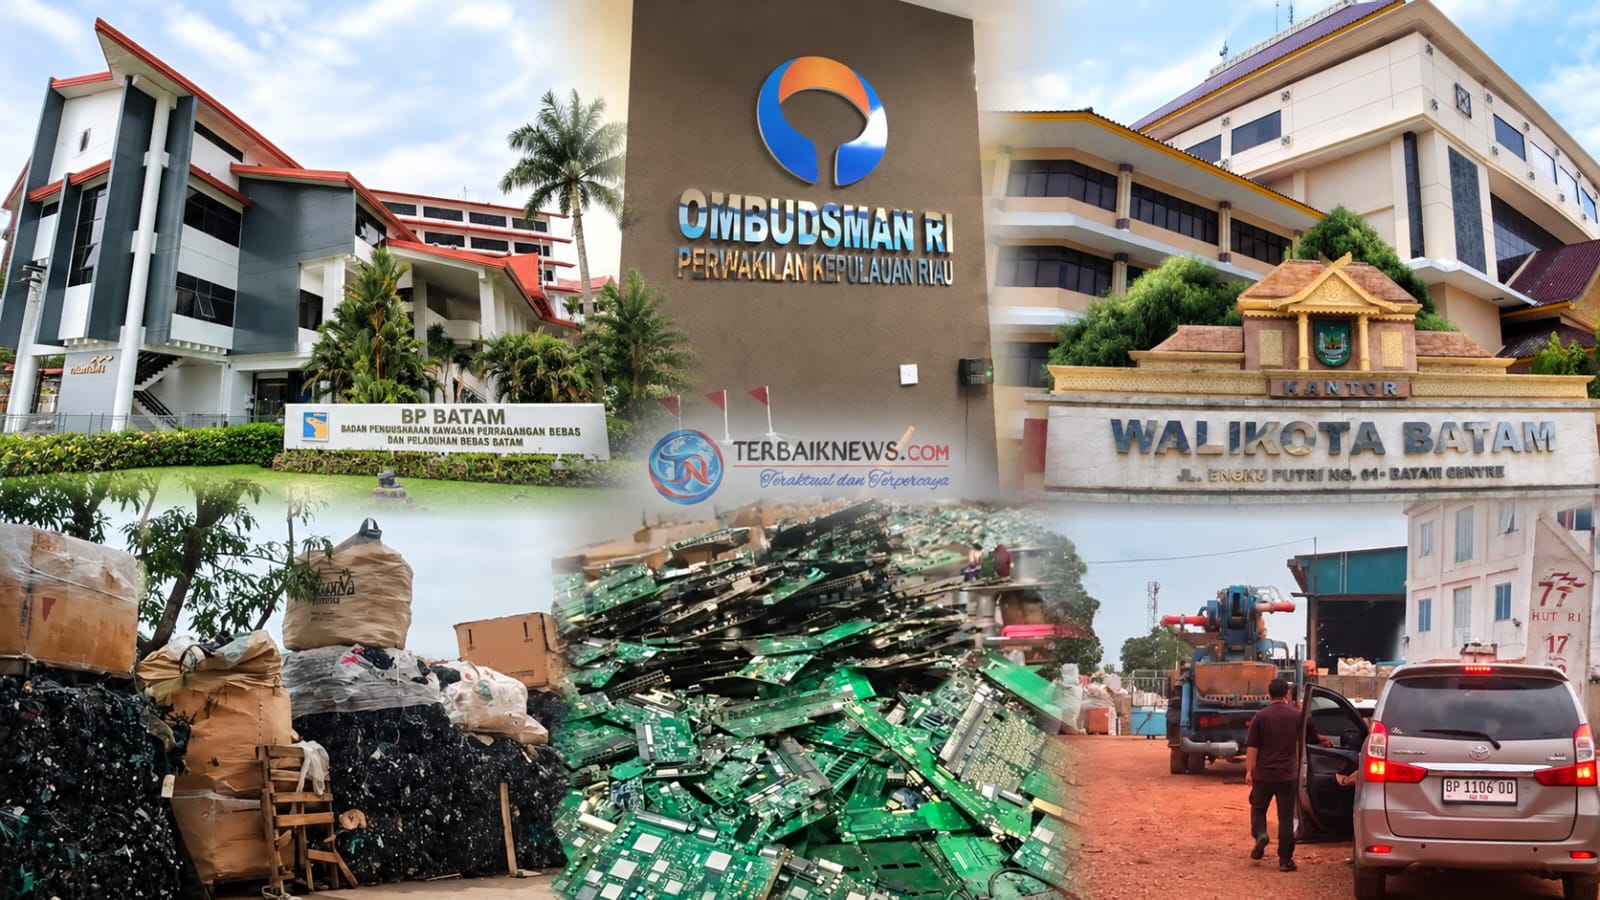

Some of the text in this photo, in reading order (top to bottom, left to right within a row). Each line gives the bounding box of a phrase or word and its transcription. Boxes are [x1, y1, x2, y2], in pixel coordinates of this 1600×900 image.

[677, 187, 954, 254] OMBUDSMAN RI
[677, 246, 954, 286] PERWAKILAN KEPULAUAN RIAU
[1282, 380, 1398, 396] KANTOR
[401, 408, 506, 425] BP BATAM
[341, 424, 367, 433] BADAN
[432, 426, 475, 435] KAWASAN
[549, 427, 581, 437] BEBAS
[1110, 418, 1558, 456] WALIKOTA BATAM
[387, 435, 405, 444] DAN
[460, 437, 490, 446] BEBAS
[493, 438, 524, 447] BATAM
[1176, 468, 1202, 482] JL.
[1328, 467, 1357, 482] NO.
[1389, 466, 1442, 480] BATAM
[1532, 611, 1582, 623] HUT RI
[1547, 634, 1569, 655] 17
[1445, 780, 1461, 793] BP
[1463, 780, 1494, 794] 1106
